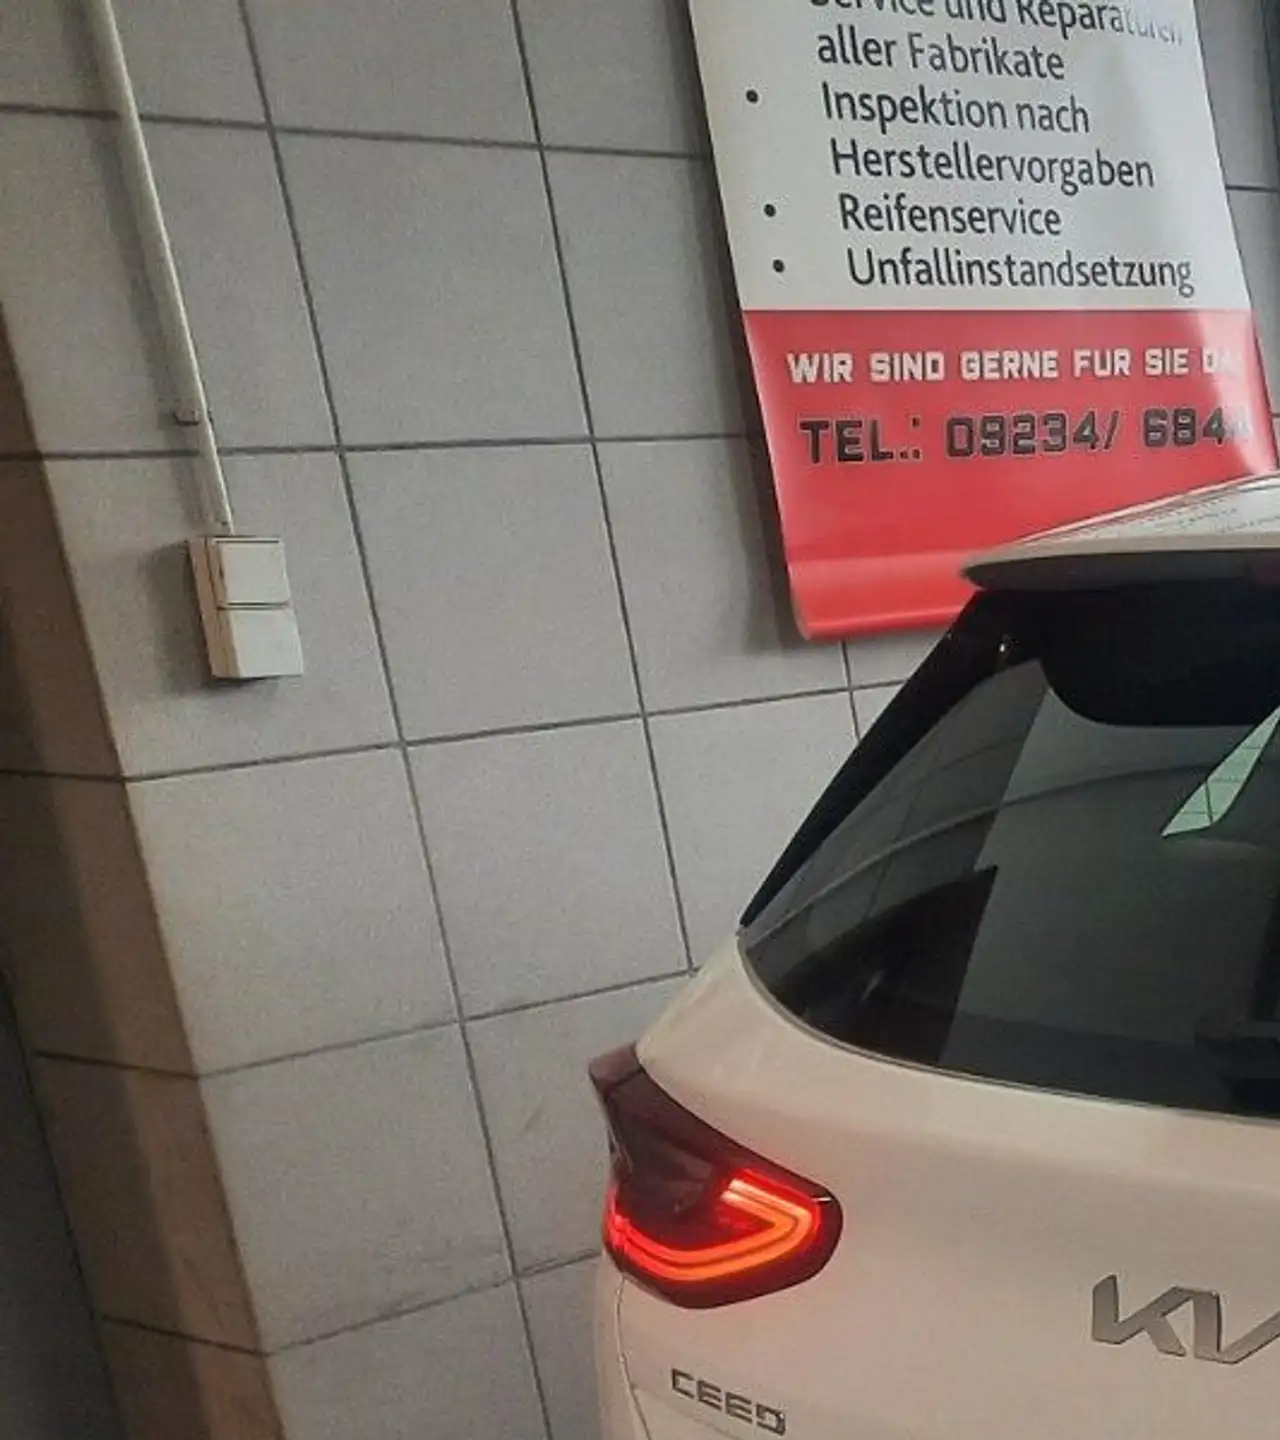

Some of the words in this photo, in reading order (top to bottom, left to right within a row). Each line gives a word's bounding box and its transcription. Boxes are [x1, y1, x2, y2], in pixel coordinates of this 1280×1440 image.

[945, 0, 1007, 23] und
[817, 24, 897, 68] aller
[908, 32, 1066, 80] Fabrikate
[821, 81, 1007, 135] Inspektion
[1016, 96, 1090, 135] nach
[829, 137, 1154, 196] Herstellervorgaben
[839, 193, 1062, 237] Reifenservice
[846, 247, 1193, 298] Unfallinstandsetzung
[787, 350, 854, 384] WIR
[869, 350, 946, 382] SIND
[960, 349, 1059, 380] GERNE
[1144, 347, 1190, 377] SIE
[799, 416, 923, 464] TEL.:
[944, 410, 1121, 459] 09234/
[671, 1368, 786, 1437] CEED
